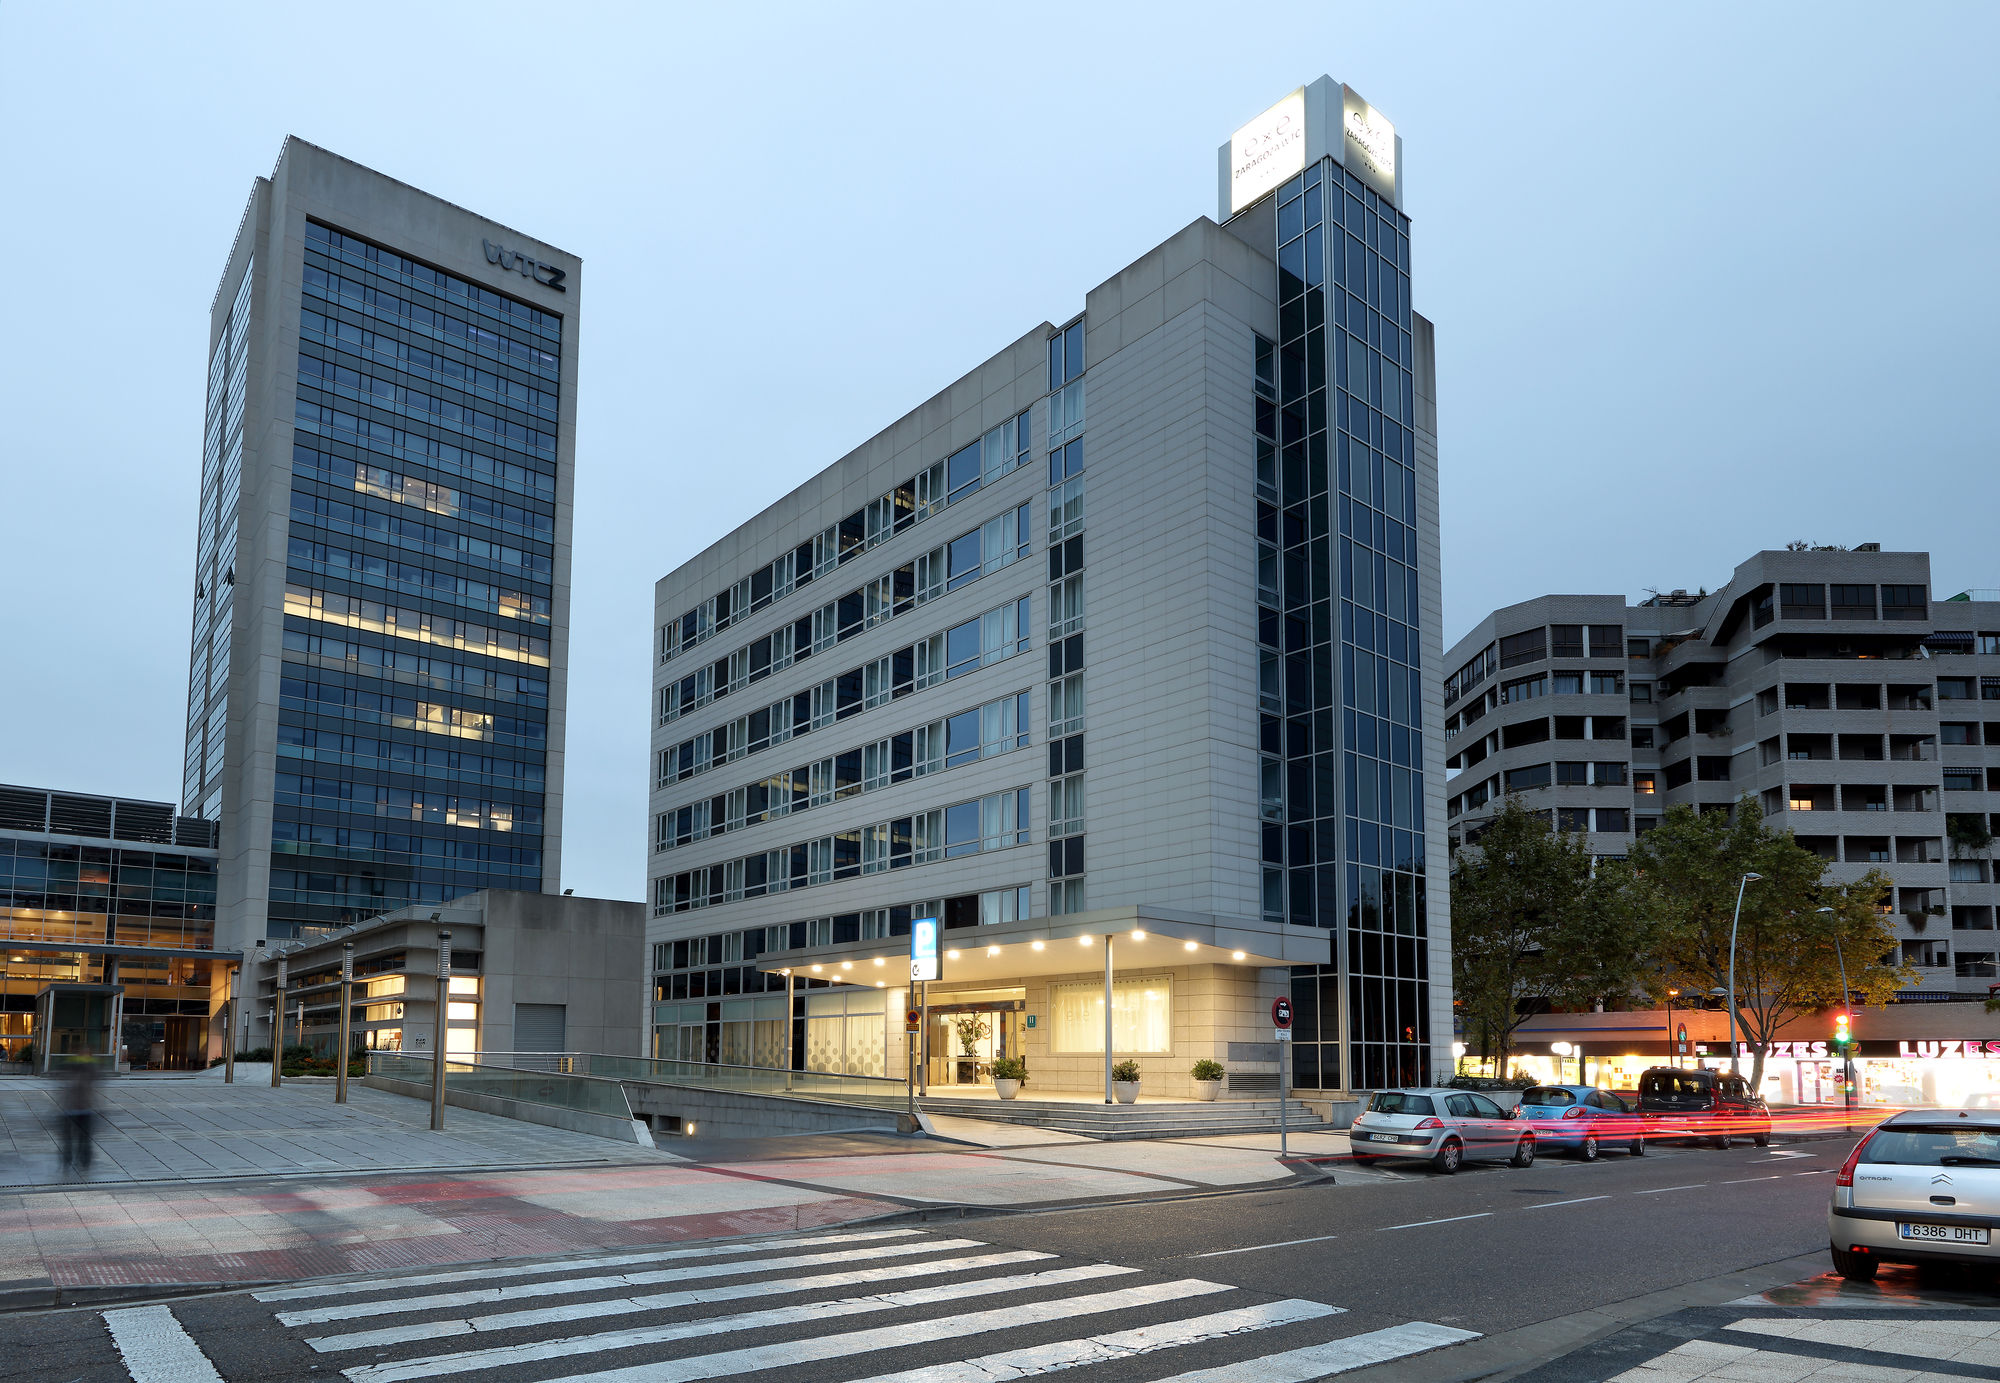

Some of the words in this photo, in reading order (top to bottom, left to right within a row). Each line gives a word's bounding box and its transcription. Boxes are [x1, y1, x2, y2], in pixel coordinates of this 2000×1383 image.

[915, 922, 935, 957] P
[1899, 1041, 2000, 1058] LUZES
[1912, 1225, 1947, 1238] 6386
[1954, 1227, 1980, 1240] DHT
